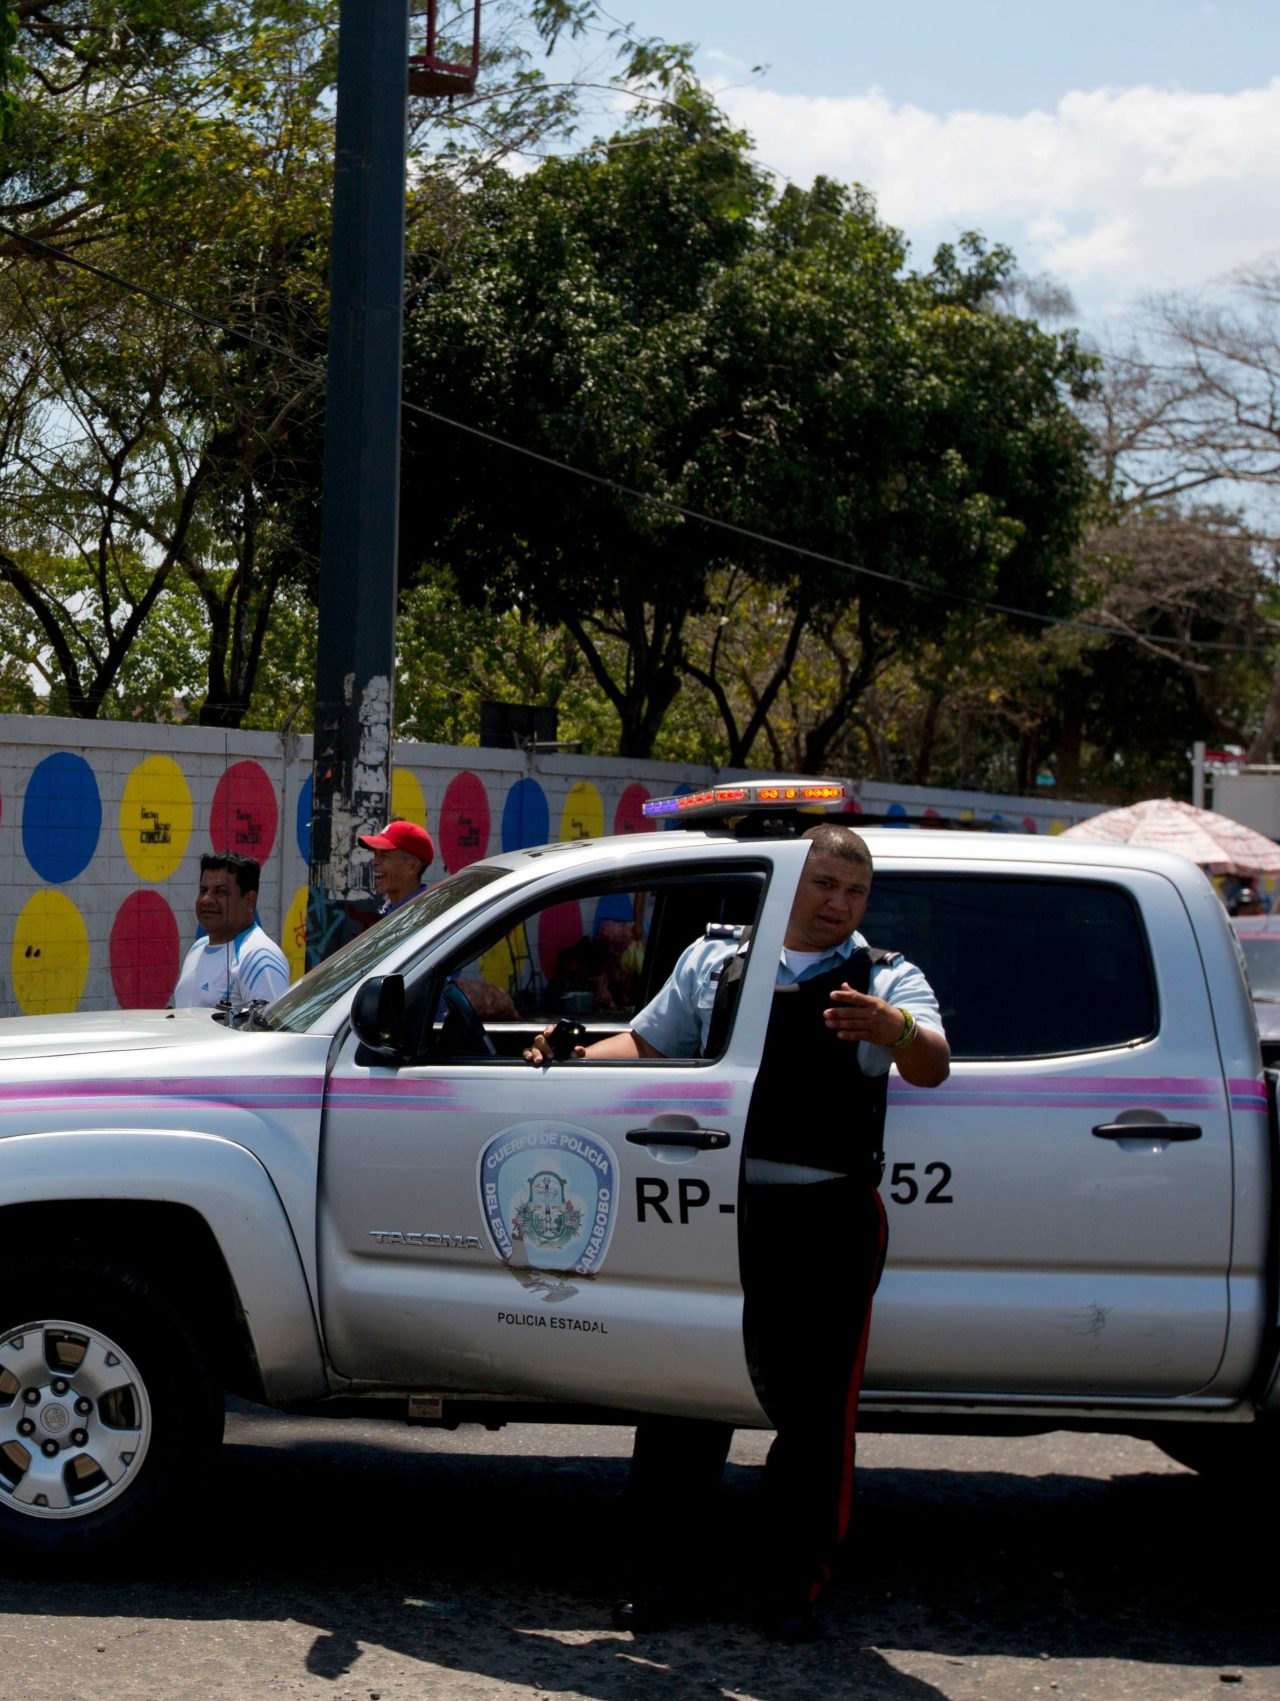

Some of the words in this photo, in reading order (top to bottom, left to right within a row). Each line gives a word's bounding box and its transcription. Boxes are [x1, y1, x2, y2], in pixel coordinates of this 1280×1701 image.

[486, 1133, 538, 1169] CUERPO
[540, 1132, 558, 1145] DE
[559, 1134, 610, 1175] POLICÍA
[485, 1183, 498, 1216] DEL
[368, 1230, 484, 1250] TACOMA
[575, 1187, 611, 1275] CARABOBO
[497, 1311, 547, 1329] POLICIA
[549, 1317, 609, 1335] ESTADAL
